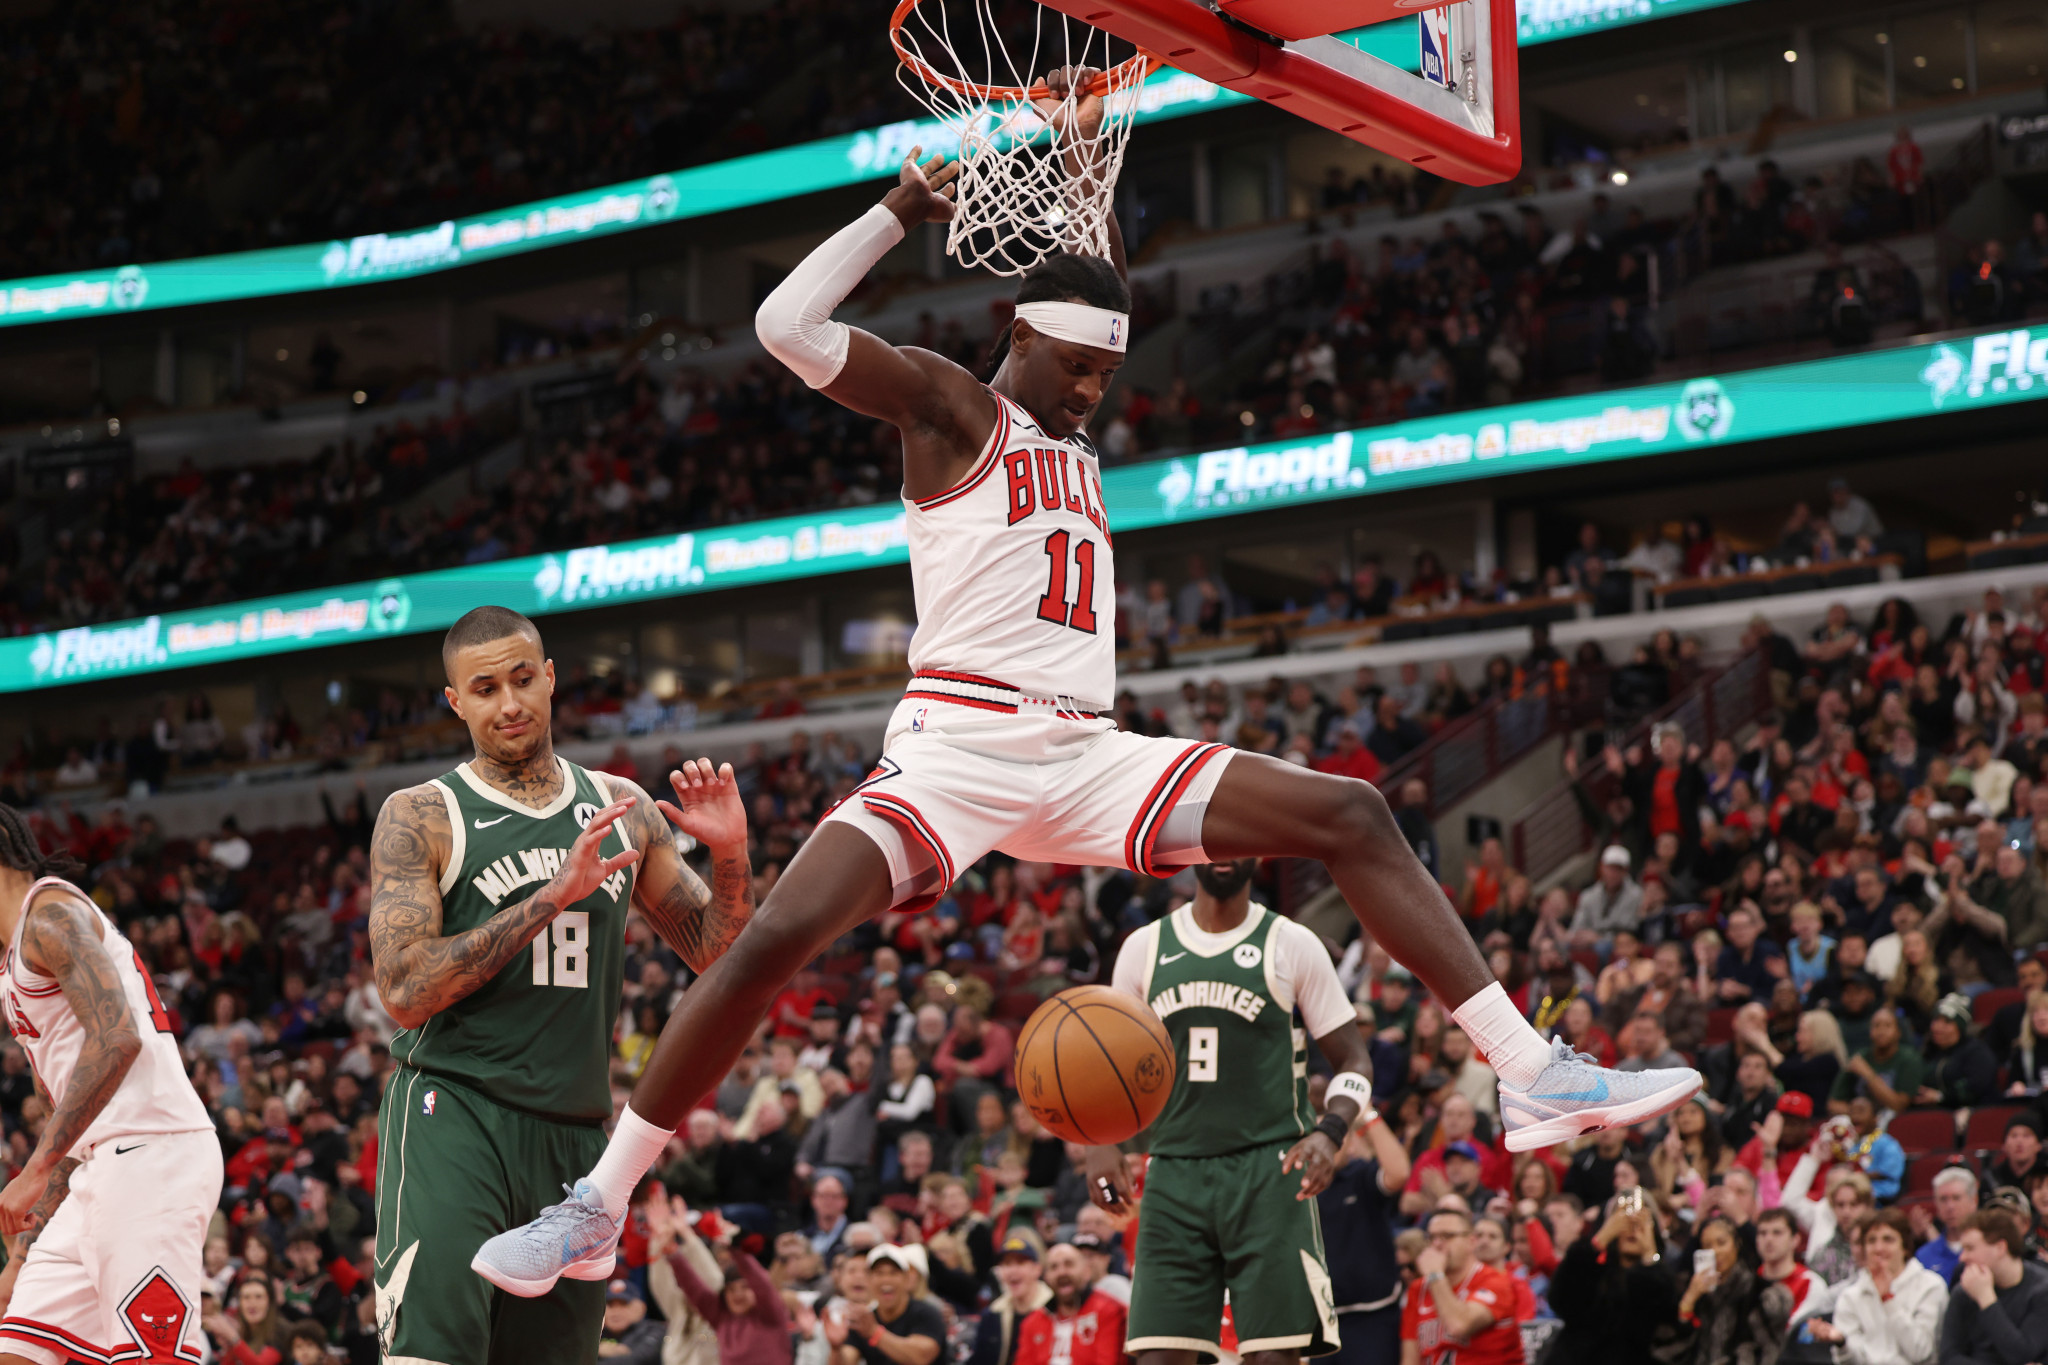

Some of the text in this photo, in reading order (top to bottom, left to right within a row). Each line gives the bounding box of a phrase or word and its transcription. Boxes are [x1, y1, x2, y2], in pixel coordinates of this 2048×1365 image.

[1424, 50, 1440, 77] NBA
[1970, 329, 2048, 383] Flo
[1194, 431, 1354, 495] Flood
[564, 533, 695, 595] Flood
[1036, 528, 1098, 635] 11
[54, 615, 161, 669] Flood
[472, 847, 627, 907] MILWAE
[392, 906, 420, 924] 75
[532, 910, 590, 989] 18
[1150, 980, 1267, 1023] MILWAUKEE
[1187, 1026, 1219, 1083] 9
